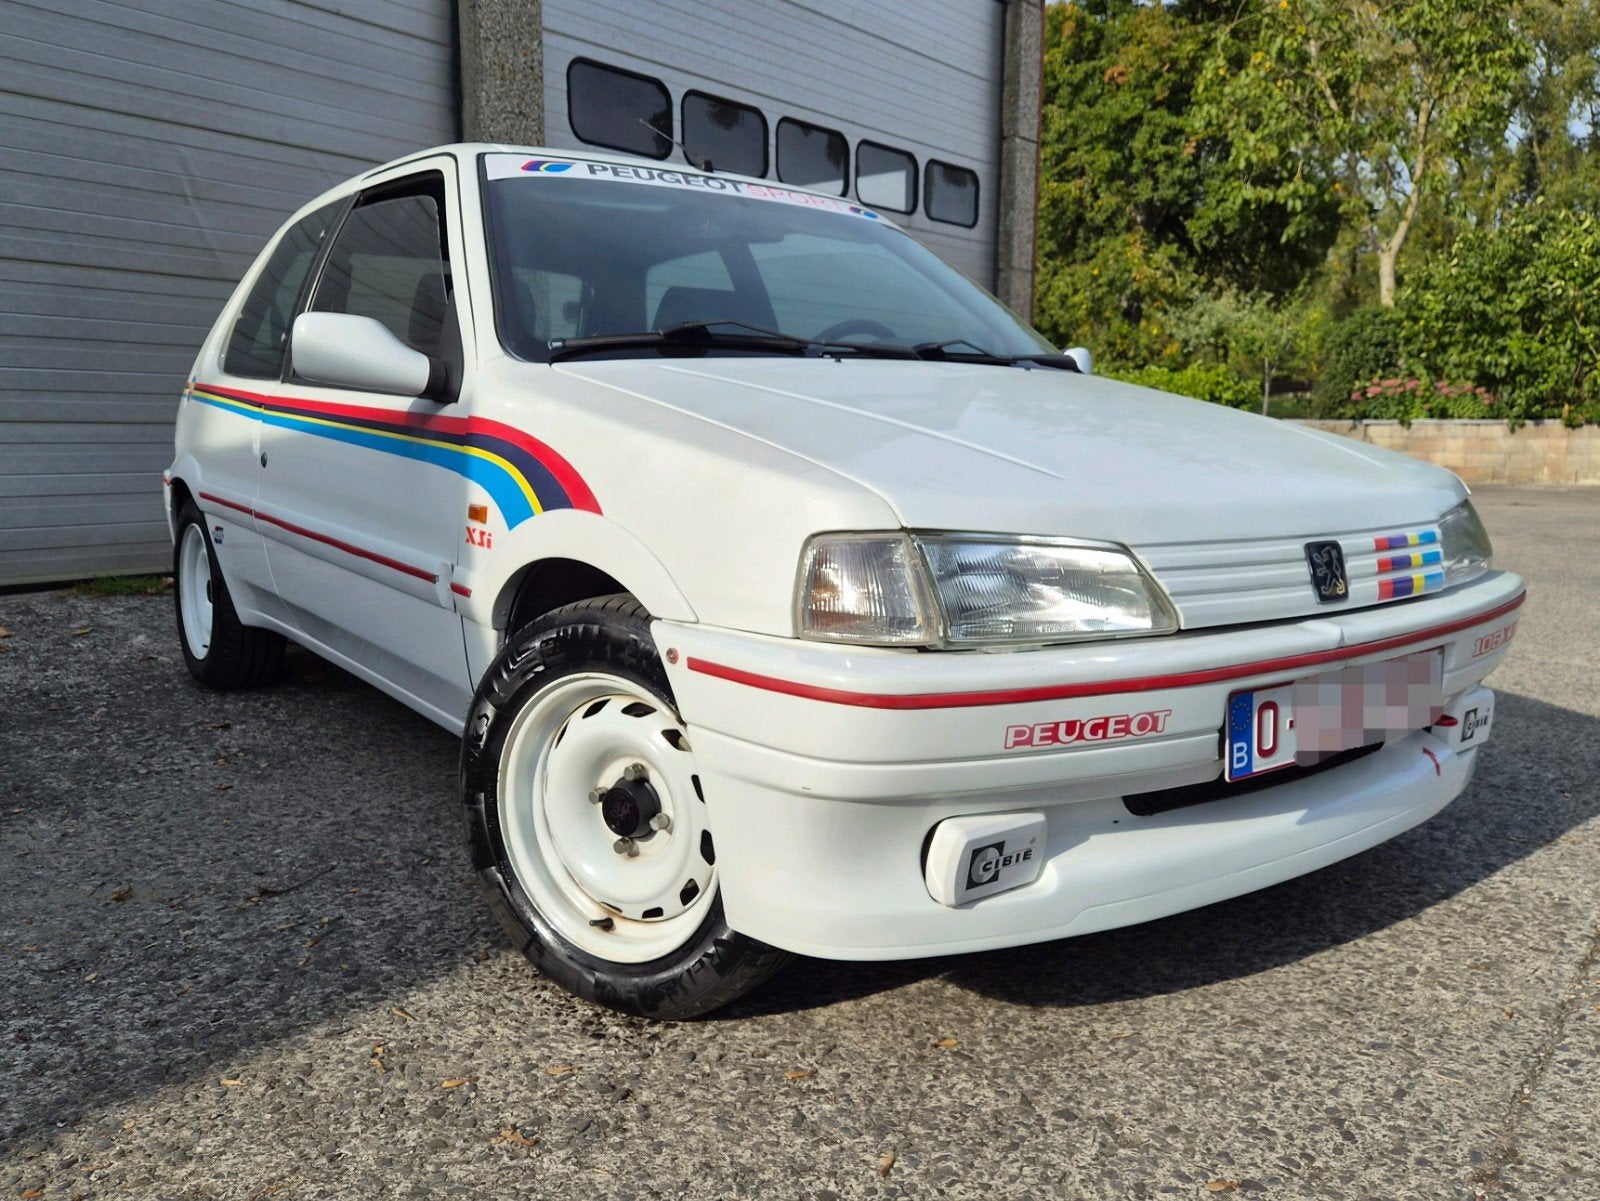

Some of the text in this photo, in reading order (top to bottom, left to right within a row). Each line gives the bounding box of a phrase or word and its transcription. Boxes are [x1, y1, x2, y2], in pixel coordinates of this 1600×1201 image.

[586, 163, 743, 193] PEUGEOT
[1004, 709, 1172, 749] PEUGEOT
[1233, 741, 1249, 769] B
[981, 848, 1033, 873] CIBIE
